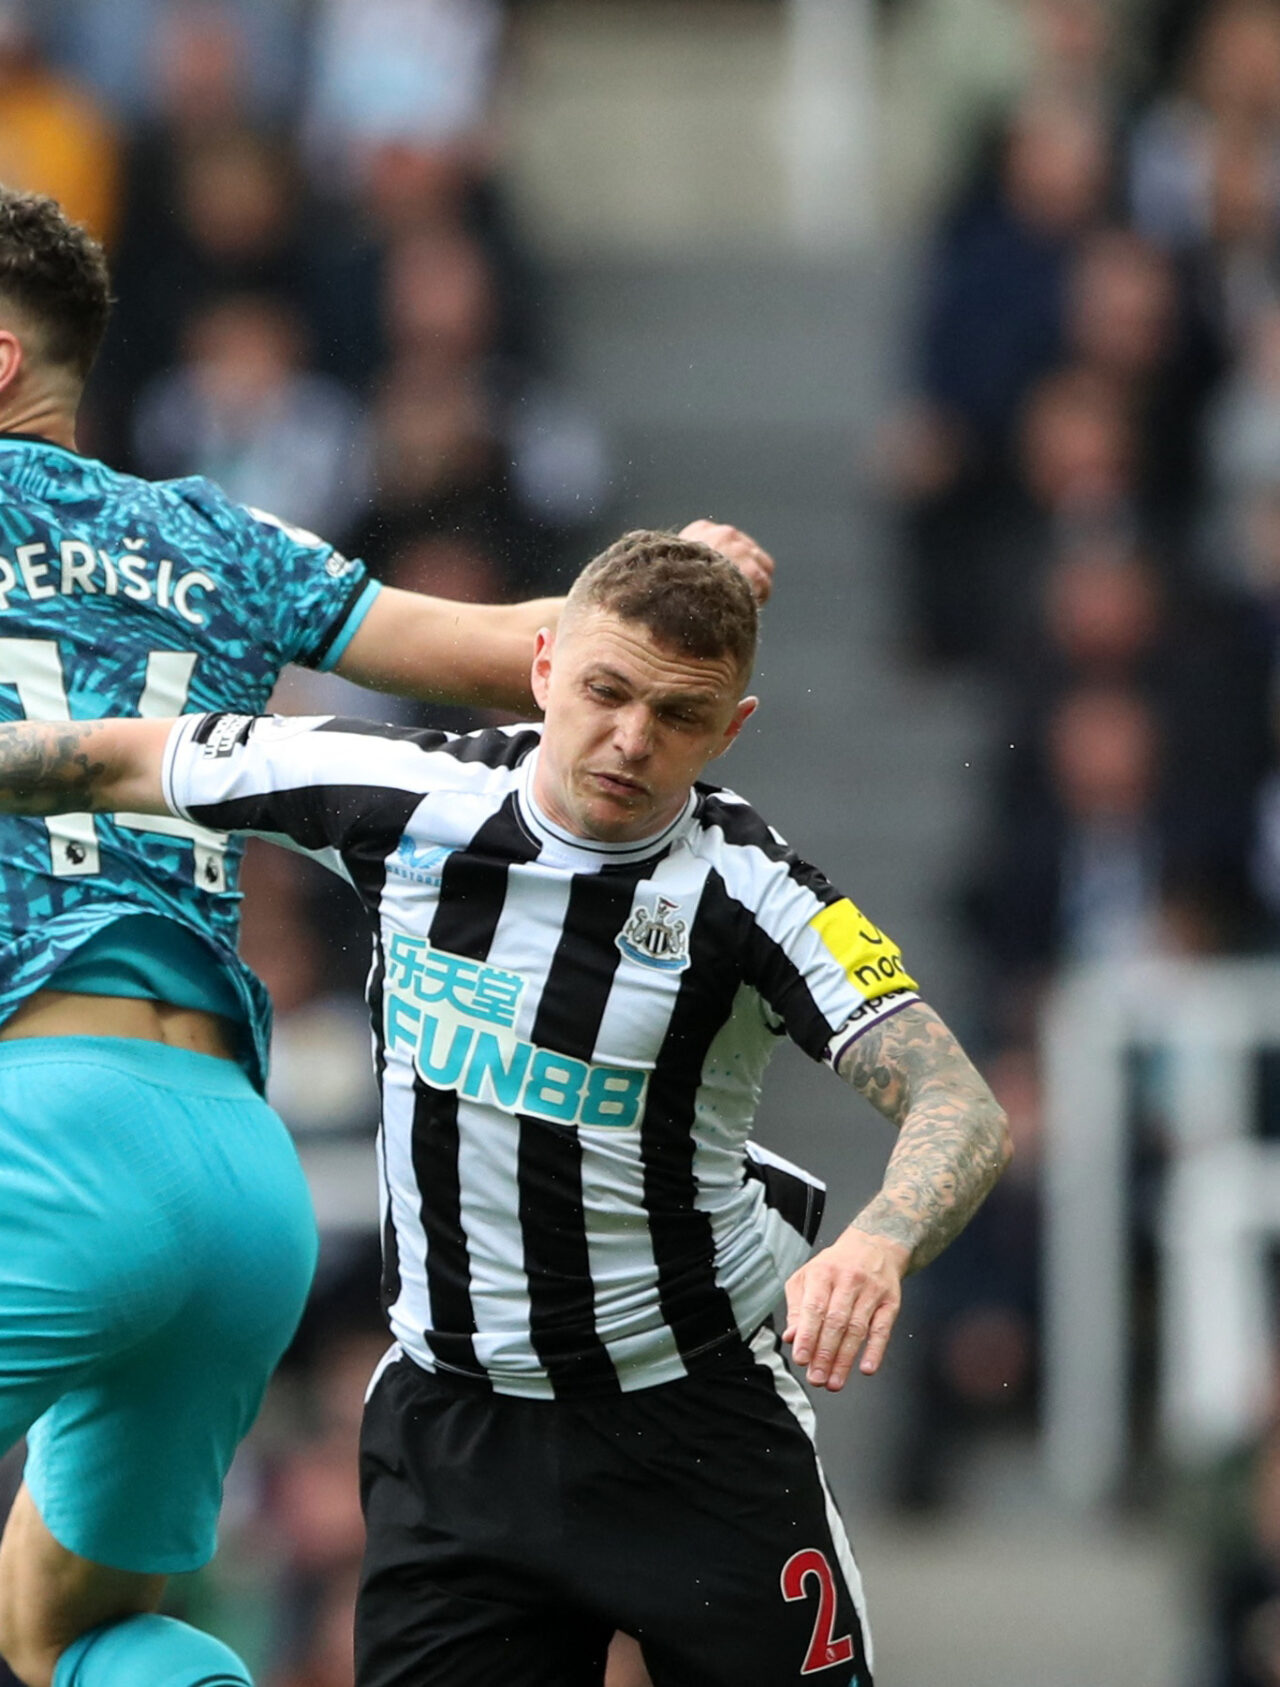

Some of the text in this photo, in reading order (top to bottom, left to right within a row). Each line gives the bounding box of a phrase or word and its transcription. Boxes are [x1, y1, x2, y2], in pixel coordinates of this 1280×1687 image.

[388, 931, 524, 1029] 乐天堂
[387, 993, 647, 1127] FUN88
[780, 1548, 854, 1675] 2
